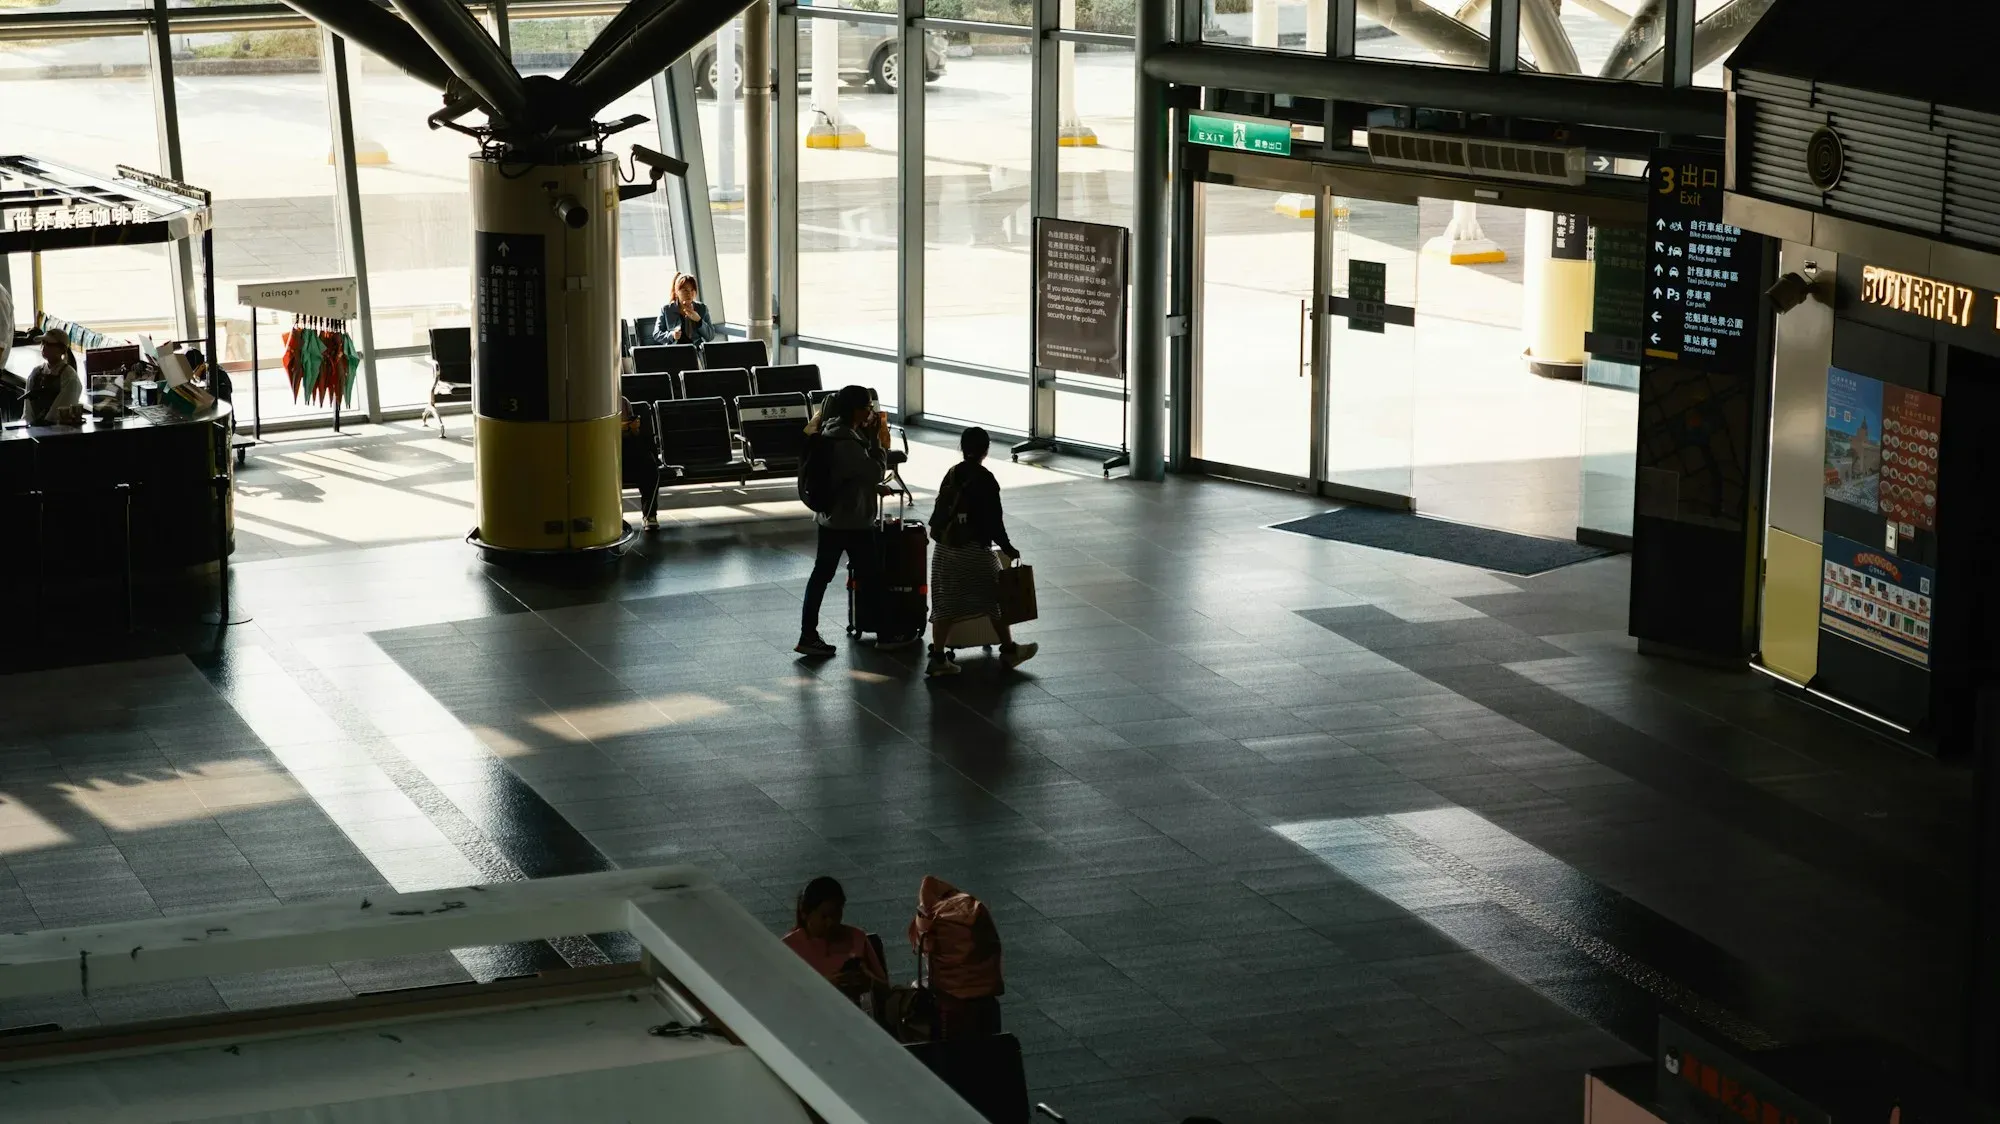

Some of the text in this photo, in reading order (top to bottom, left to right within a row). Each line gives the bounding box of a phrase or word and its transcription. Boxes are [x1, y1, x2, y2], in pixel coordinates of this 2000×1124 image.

[1199, 131, 1224, 142] EXIT
[1659, 164, 1718, 194] 3 出口
[1680, 191, 1702, 206] Exit
[14, 204, 150, 232] 世界最佳咖啡館
[1556, 213, 1567, 248] 載客區
[1689, 230, 1700, 238] Bike
[1701, 232, 1725, 242] assembly
[1688, 243, 1731, 258] 臨停載客區
[1688, 254, 1705, 263] Pickup
[1687, 266, 1739, 282] 計程車乘車區
[1698, 279, 1715, 287] pickup
[1062, 286, 1086, 295] encounter
[1686, 289, 1711, 302] 停車場
[1861, 265, 1974, 327] BUTTERFLY
[1061, 295, 1088, 305] solicitation,
[1047, 302, 1065, 310] contact
[1074, 306, 1091, 314] station
[1047, 312, 1066, 320] security
[1684, 334, 1717, 348] 車站廣場
[1683, 345, 1716, 355] Station plaza
